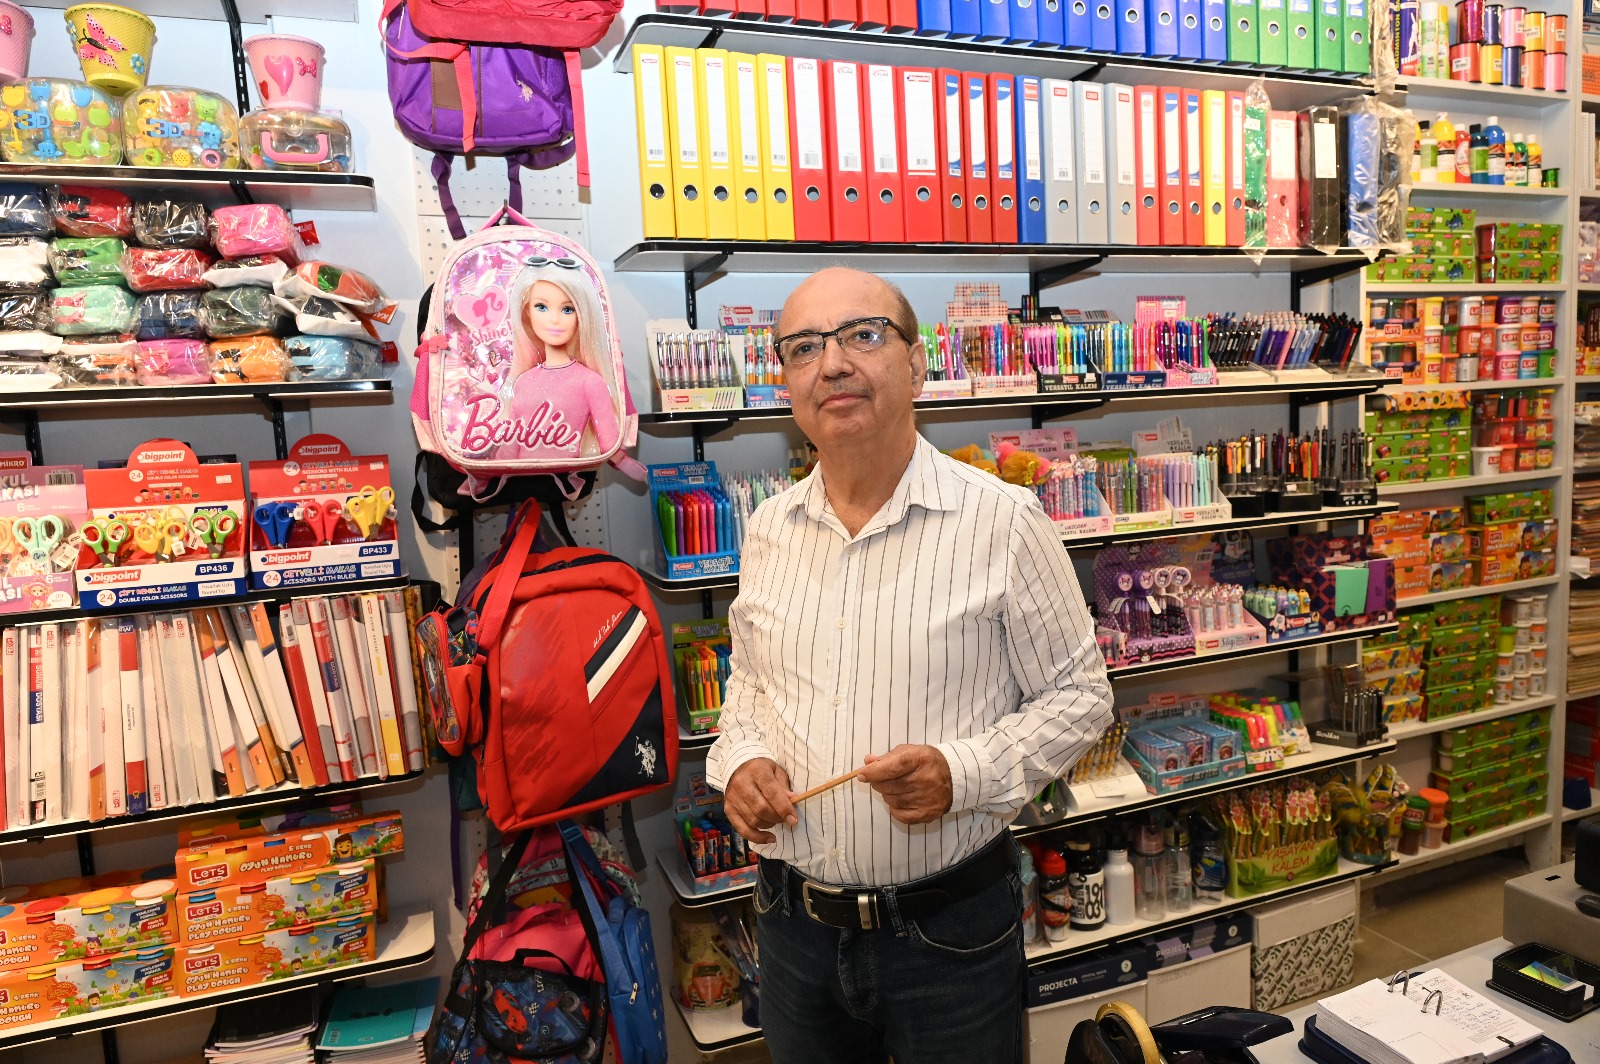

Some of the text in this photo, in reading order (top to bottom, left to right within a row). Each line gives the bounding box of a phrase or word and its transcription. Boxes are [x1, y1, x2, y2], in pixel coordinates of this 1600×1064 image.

[469, 319, 513, 346] Shine!
[460, 393, 579, 451] Barbie
[144, 451, 183, 461] bigpoint
[305, 445, 339, 454] bigpoint
[130, 472, 141, 480] 24
[285, 465, 298, 473] 24
[0, 485, 39, 501] KASI
[268, 546, 388, 564] bigpoint BP433
[93, 564, 228, 583] bigpoint BP436
[265, 574, 279, 583] 24
[283, 577, 317, 585] SCISSORS
[99, 593, 114, 603] 24
[1266, 841, 1316, 861] YAŞAYAN
[1272, 856, 1311, 874] KALEM
[188, 925, 243, 941] PLAY DOUGH
[1155, 943, 1191, 958] PROJECTA
[186, 976, 242, 993] PLAY DOUGH
[1038, 977, 1078, 994] PROJECTA
